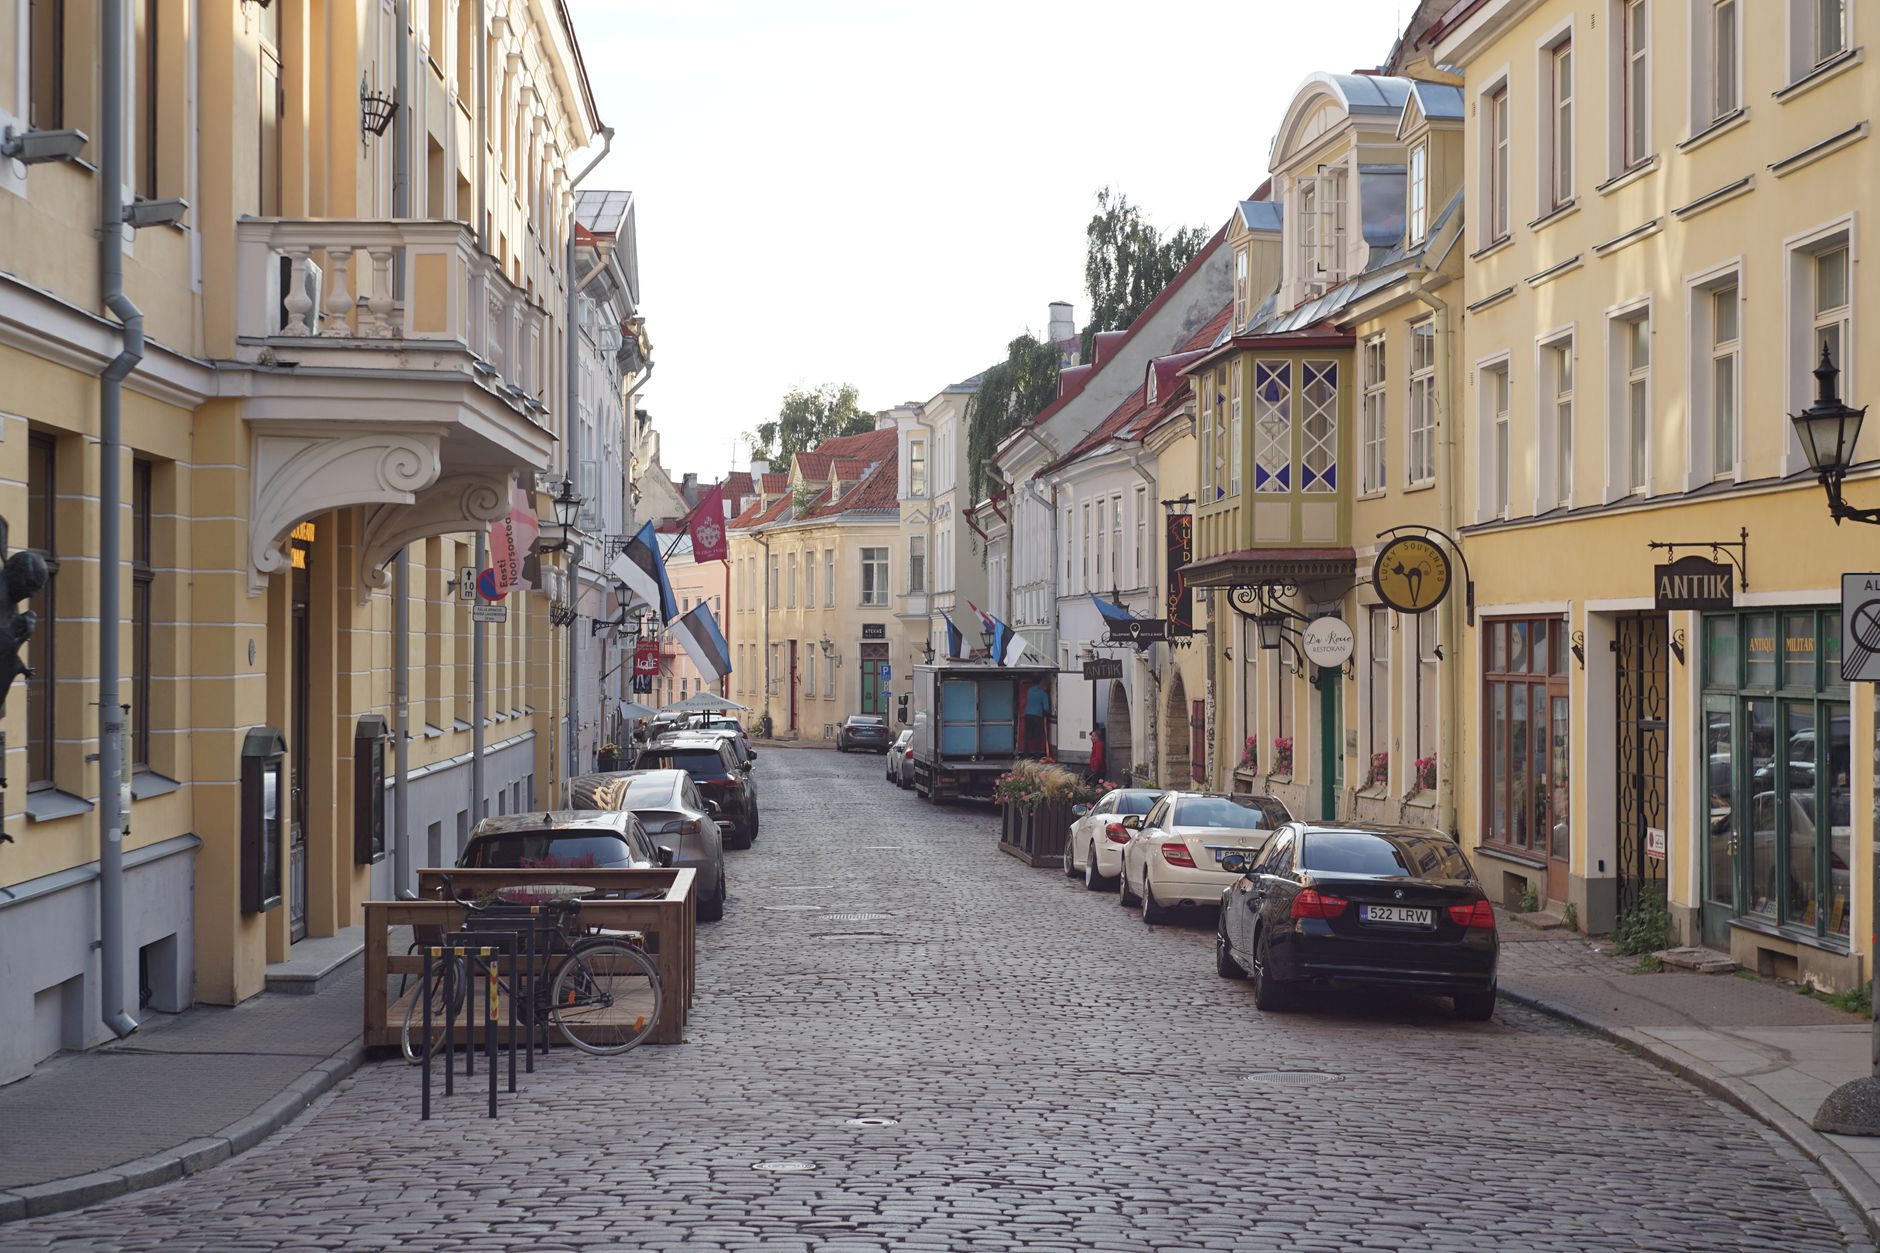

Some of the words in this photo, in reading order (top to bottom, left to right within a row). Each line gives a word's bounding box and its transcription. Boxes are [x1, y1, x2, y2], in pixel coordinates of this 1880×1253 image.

[504, 513, 518, 586] Noorsootea
[1381, 549, 1397, 581] LUCKY
[1403, 542, 1445, 582] SOUVENIRS
[497, 559, 507, 588] Eesti
[464, 582, 474, 590] 10
[1659, 575, 1730, 599] ANTIIK
[1864, 580, 1880, 591] AL
[465, 590, 473, 598] m
[1085, 663, 1121, 678] ANTIIK
[1370, 907, 1393, 920] 522
[1398, 909, 1428, 922] LRW
